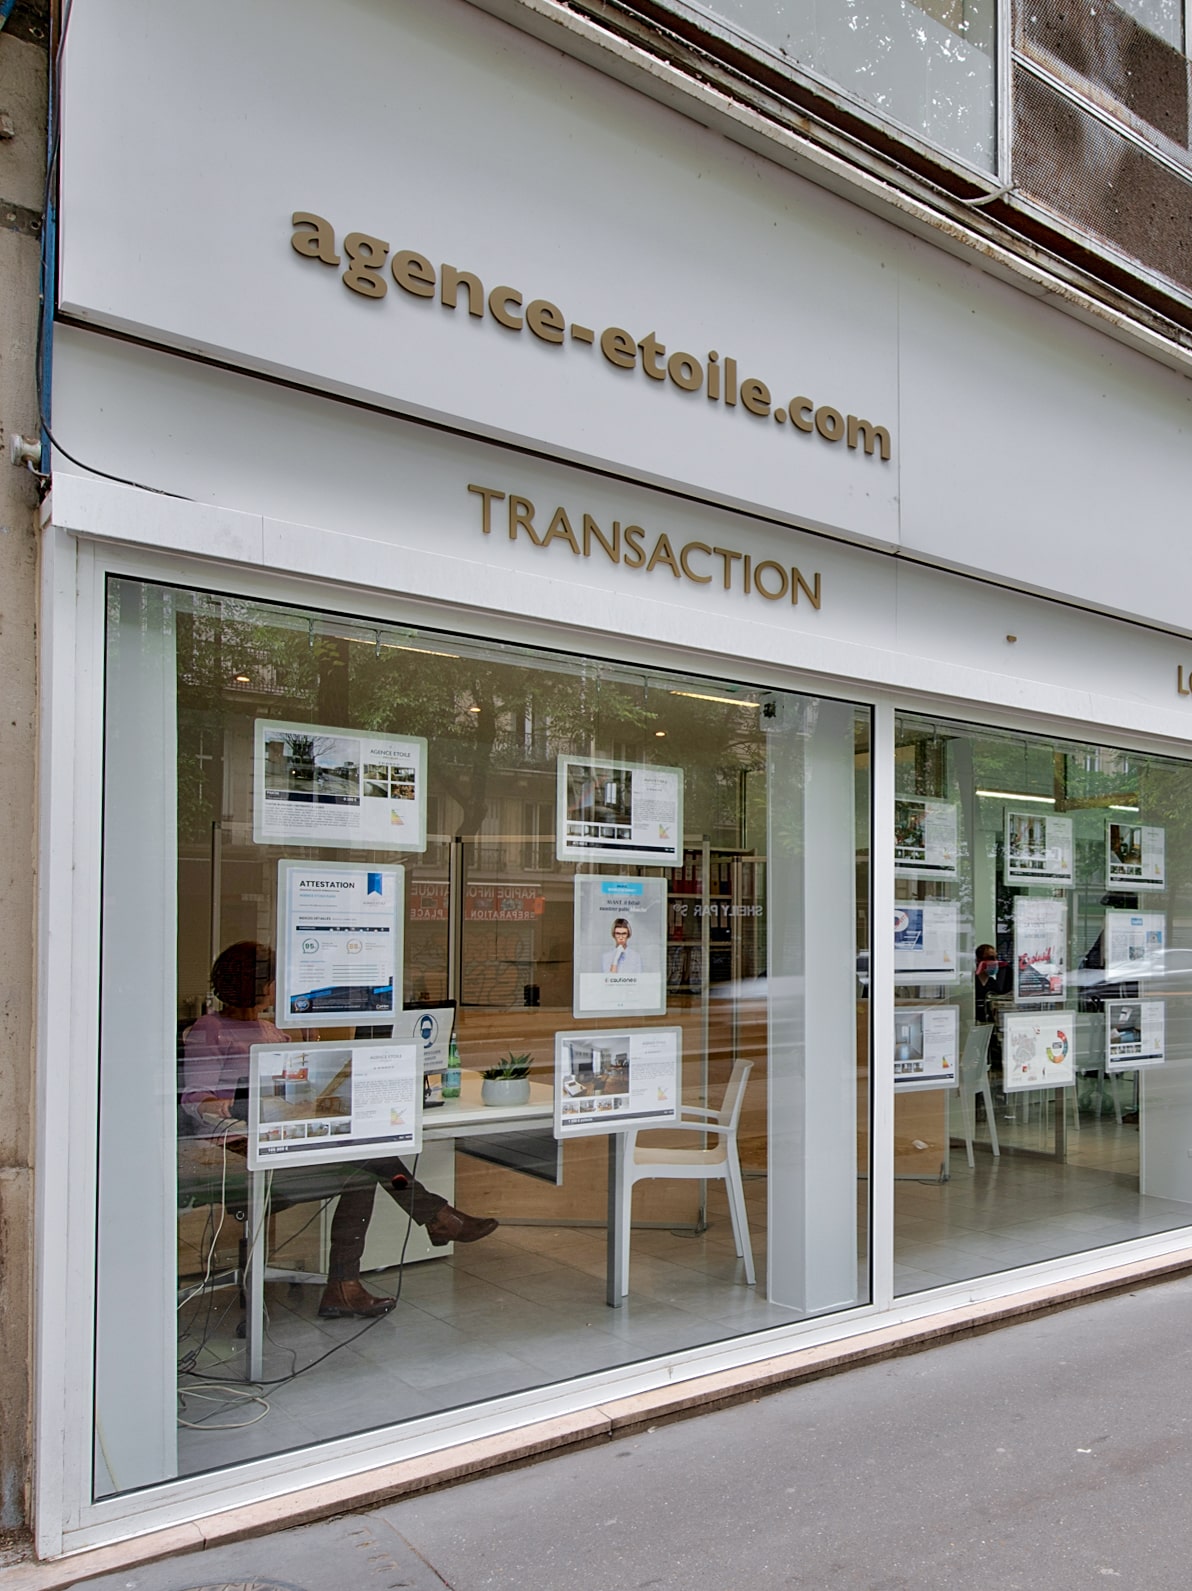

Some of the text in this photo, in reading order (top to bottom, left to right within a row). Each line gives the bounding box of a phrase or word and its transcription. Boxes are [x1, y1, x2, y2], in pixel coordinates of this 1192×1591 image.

[290, 211, 892, 461] agence-etoile.com
[467, 483, 822, 610] TRANSACTION
[299, 880, 355, 889] ATTESTATION
